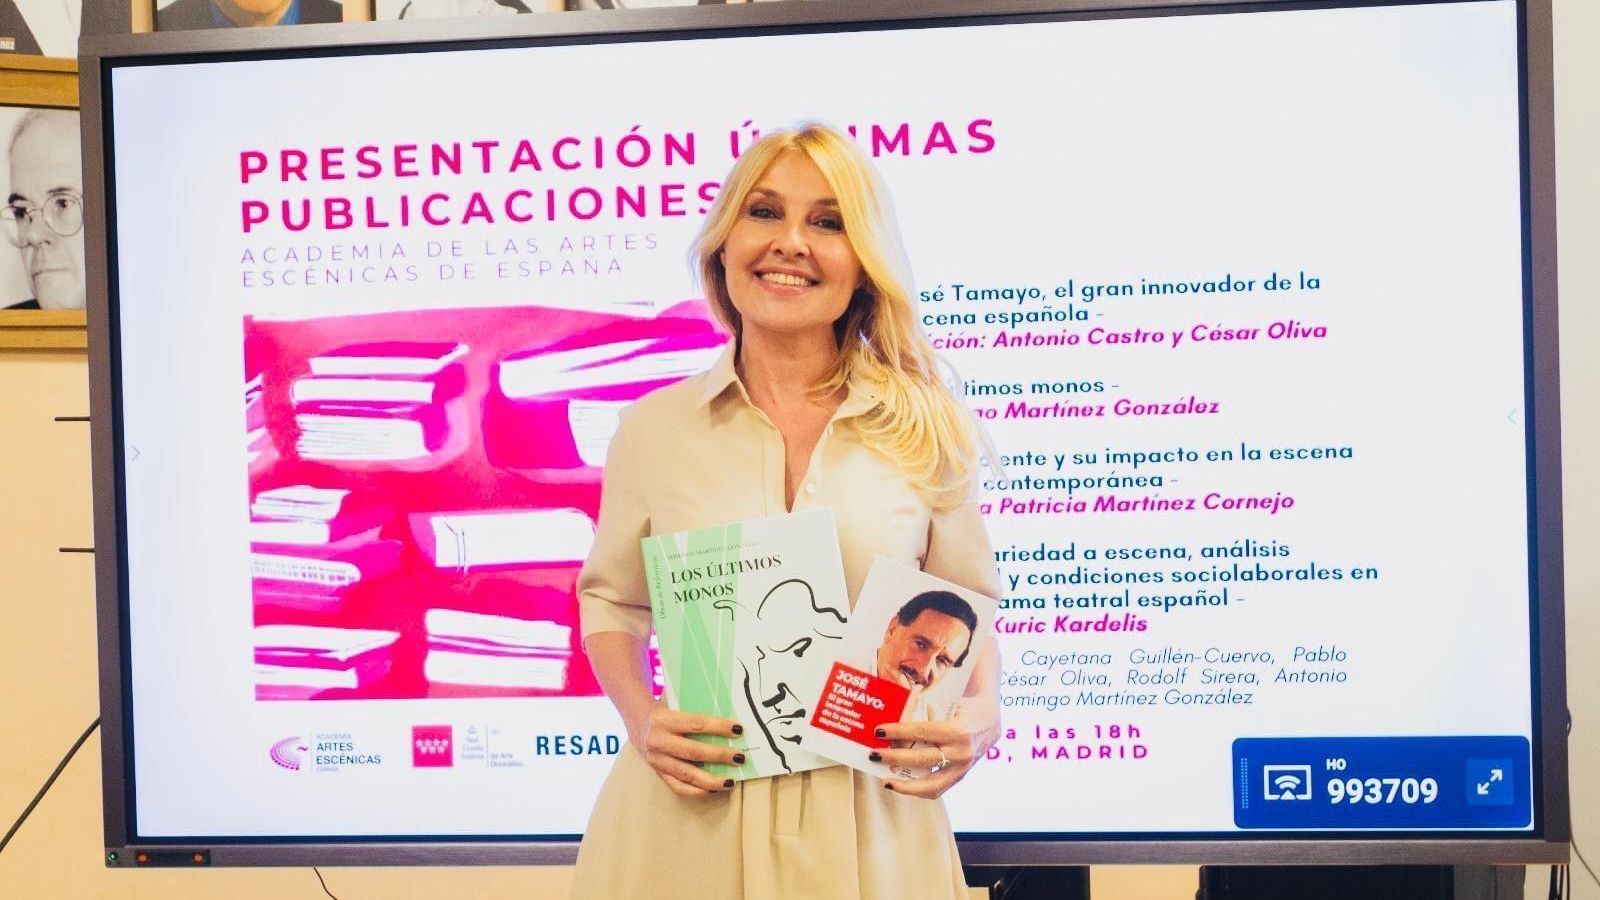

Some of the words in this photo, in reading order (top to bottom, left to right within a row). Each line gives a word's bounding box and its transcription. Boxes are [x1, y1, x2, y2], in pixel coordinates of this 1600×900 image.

[239, 125, 696, 184] PRESENTACIÓN
[730, 118, 997, 160] ÚMAS
[241, 182, 721, 233] PUBLICACIONES
[241, 243, 406, 265] ACADEMIA
[427, 240, 465, 259] DE
[485, 237, 539, 256] LAS
[559, 233, 659, 254] ARTES
[242, 264, 421, 288] ESCÉNICAS
[440, 263, 475, 282] DE
[497, 256, 623, 279] ESPAÑA
[920, 285, 944, 302] sé
[952, 285, 1047, 304] Tamayo,
[1054, 279, 1073, 298] el
[1081, 284, 1133, 302] gran
[1141, 274, 1256, 295] innovador
[1264, 273, 1292, 291] de
[1301, 271, 1320, 289] la
[922, 313, 976, 326] cena
[984, 304, 1089, 329] española
[993, 331, 1080, 348] Antonio
[1087, 327, 1164, 345] Castro
[1172, 332, 1183, 348] y
[1191, 324, 1261, 341] César
[1268, 320, 1328, 340] Oliva
[964, 379, 1023, 396] timos
[1031, 382, 1105, 394] monos
[1004, 400, 1105, 418] Martínez
[1114, 396, 1221, 417] González
[1054, 454, 1065, 471] y
[1073, 453, 1097, 465] su
[1106, 447, 1199, 469] impacto
[1207, 450, 1233, 462] en
[1242, 443, 1262, 461] la
[1270, 446, 1353, 459] escena
[1000, 496, 1087, 514] Patricia
[1093, 494, 1196, 512] Martínez
[1204, 492, 1294, 514] Cornejo
[1084, 548, 1096, 560] a
[1105, 546, 1192, 561] escena,
[1201, 539, 1290, 558] análisis
[671, 568, 702, 584] LOS
[707, 555, 782, 578] ÚLTIMOS
[1009, 574, 1019, 591] y
[1027, 566, 1163, 585] condiciones
[1171, 562, 1343, 582] sociolaborales
[1351, 566, 1378, 579] en
[674, 583, 734, 604] MONOS
[1054, 589, 1129, 608] teatral
[1138, 588, 1228, 612] español
[1054, 613, 1147, 633] Kardelis
[1021, 650, 1112, 669] Cayetana
[1129, 648, 1275, 665] Guillén-Cuervo,
[1293, 646, 1347, 663] Pablo
[836, 670, 869, 690] JOSÉ
[1060, 669, 1112, 687] Oliva,
[1127, 669, 1187, 685] Rodolf
[1200, 669, 1260, 685] Sirera,
[1275, 669, 1347, 683] Antonio
[832, 682, 885, 710] TAMAYO:
[1076, 690, 1157, 706] Martínez
[1164, 688, 1254, 706] González
[1006, 728, 1016, 739] a
[1036, 725, 1076, 739] las
[1094, 724, 1140, 739] 18h
[317, 743, 353, 751] ARTES
[536, 735, 620, 755] RESAD
[1032, 745, 1147, 759] MADRID
[317, 753, 382, 764] ESCÉNICAS
[1326, 758, 1347, 771] HO
[1327, 778, 1438, 804] 993709
